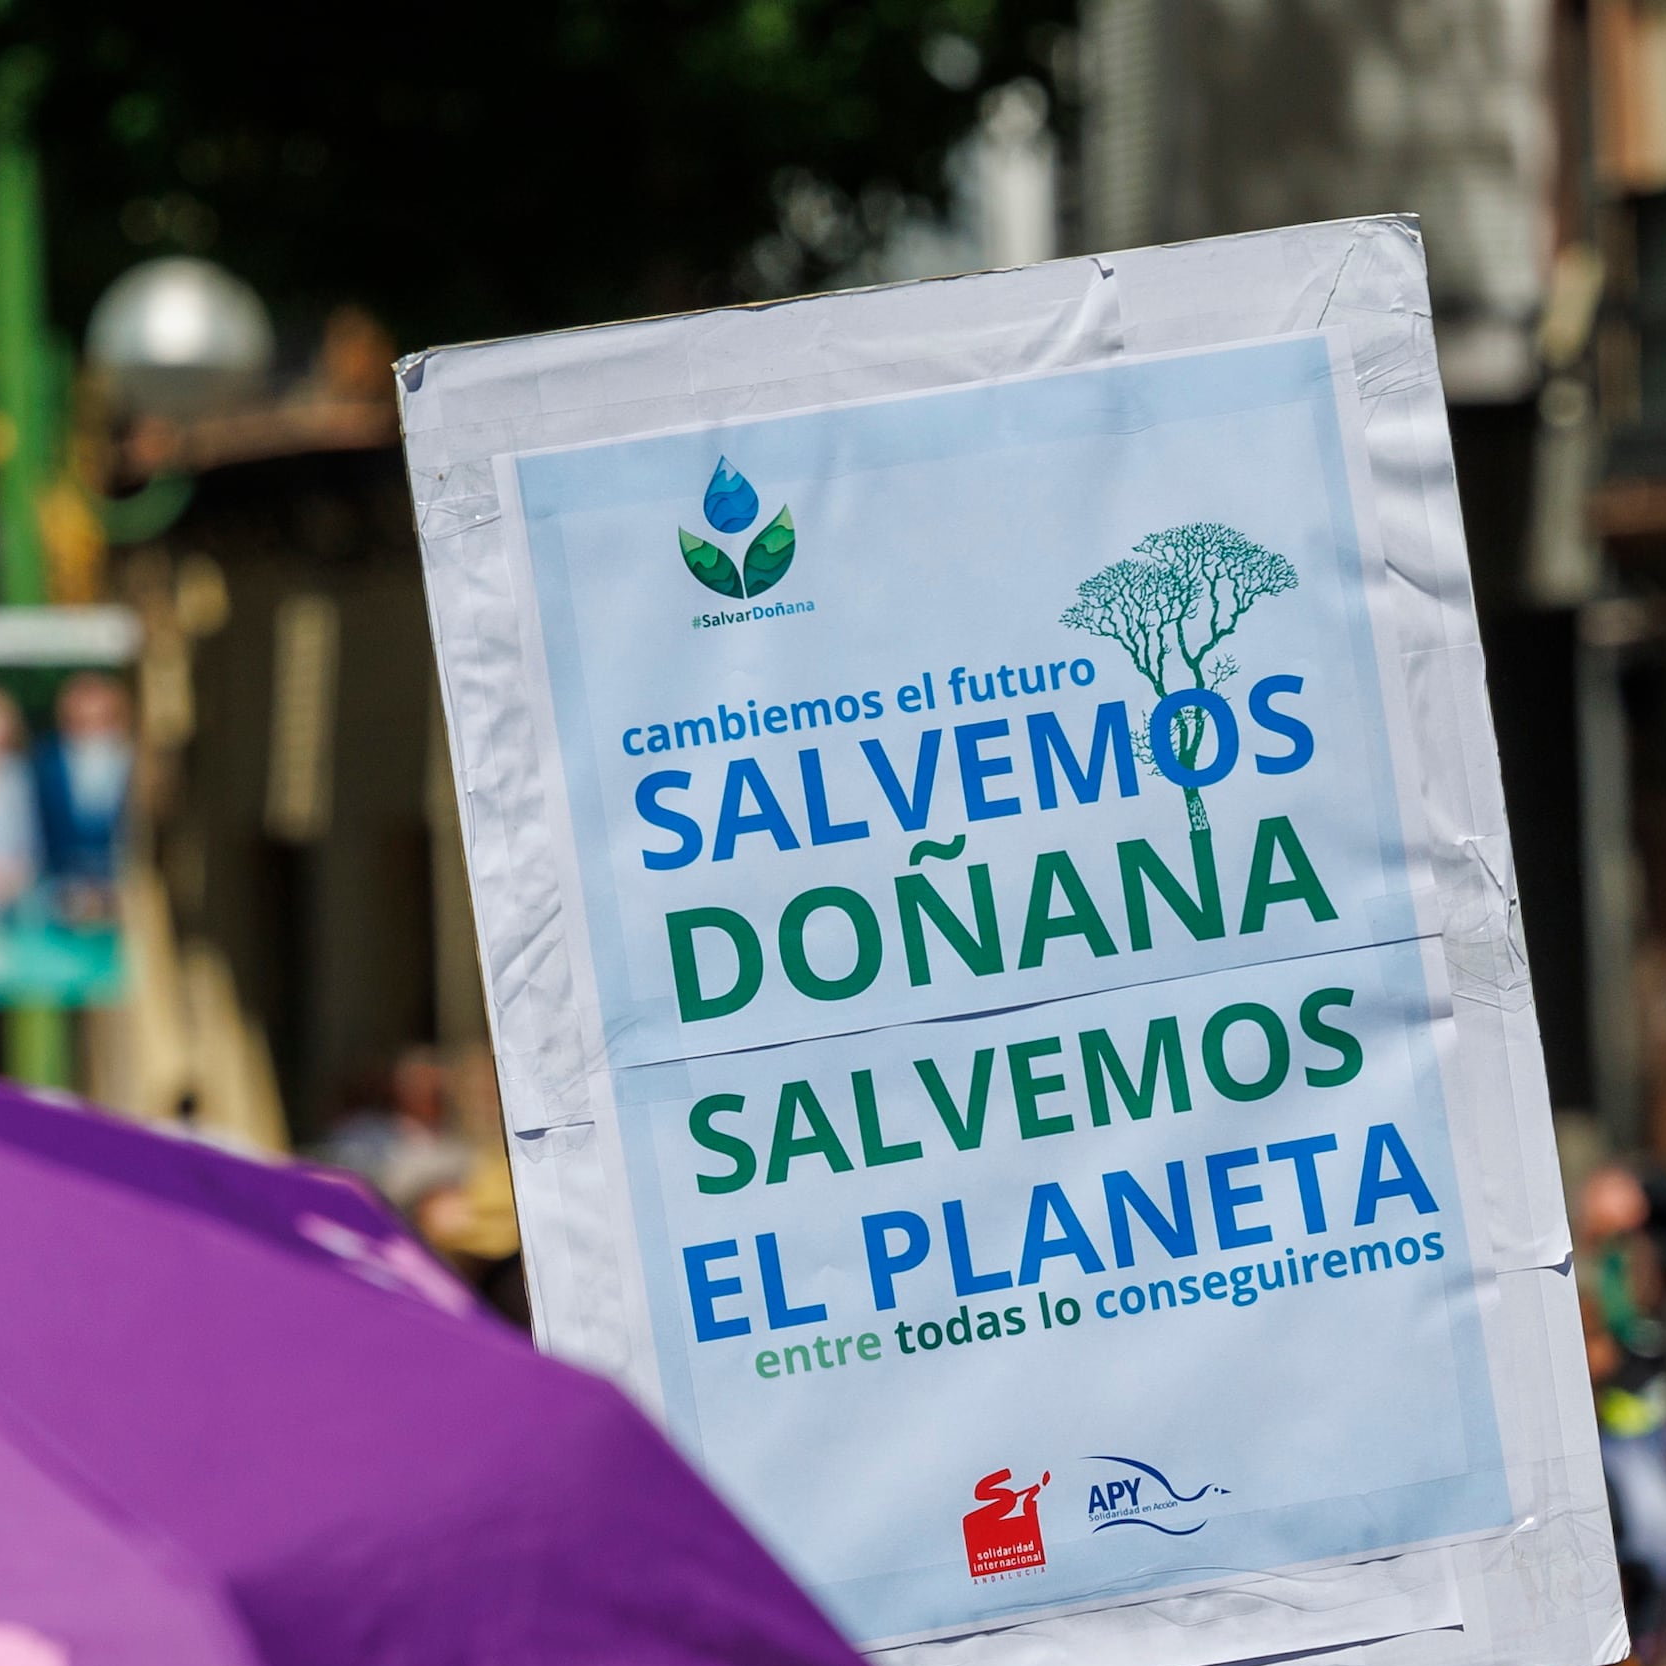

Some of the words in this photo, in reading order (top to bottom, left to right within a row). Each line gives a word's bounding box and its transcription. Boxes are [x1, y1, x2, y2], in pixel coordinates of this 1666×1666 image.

[691, 600, 816, 630] #SalvarDoñana
[622, 691, 884, 756] cambiemos
[897, 672, 936, 713] el
[948, 658, 1095, 705] futuro
[635, 675, 1314, 870] SALVEMOS
[666, 809, 1339, 1023] DOÑANA
[689, 987, 1363, 1195] SALVEMOS
[683, 1232, 827, 1342] EL
[862, 1123, 1439, 1311] PLANETA
[757, 1334, 880, 1377] entre
[894, 1305, 1026, 1354] todas
[1039, 1291, 1081, 1329] lo
[1096, 1232, 1444, 1319] conseguiremos
[1088, 1477, 1142, 1514] APY
[1088, 1506, 1140, 1522] Solidaridad
[1141, 1505, 1152, 1514] en
[1153, 1499, 1178, 1512] Acción
[973, 1550, 1042, 1574] internacional
[976, 1540, 1034, 1561] solidaridad
